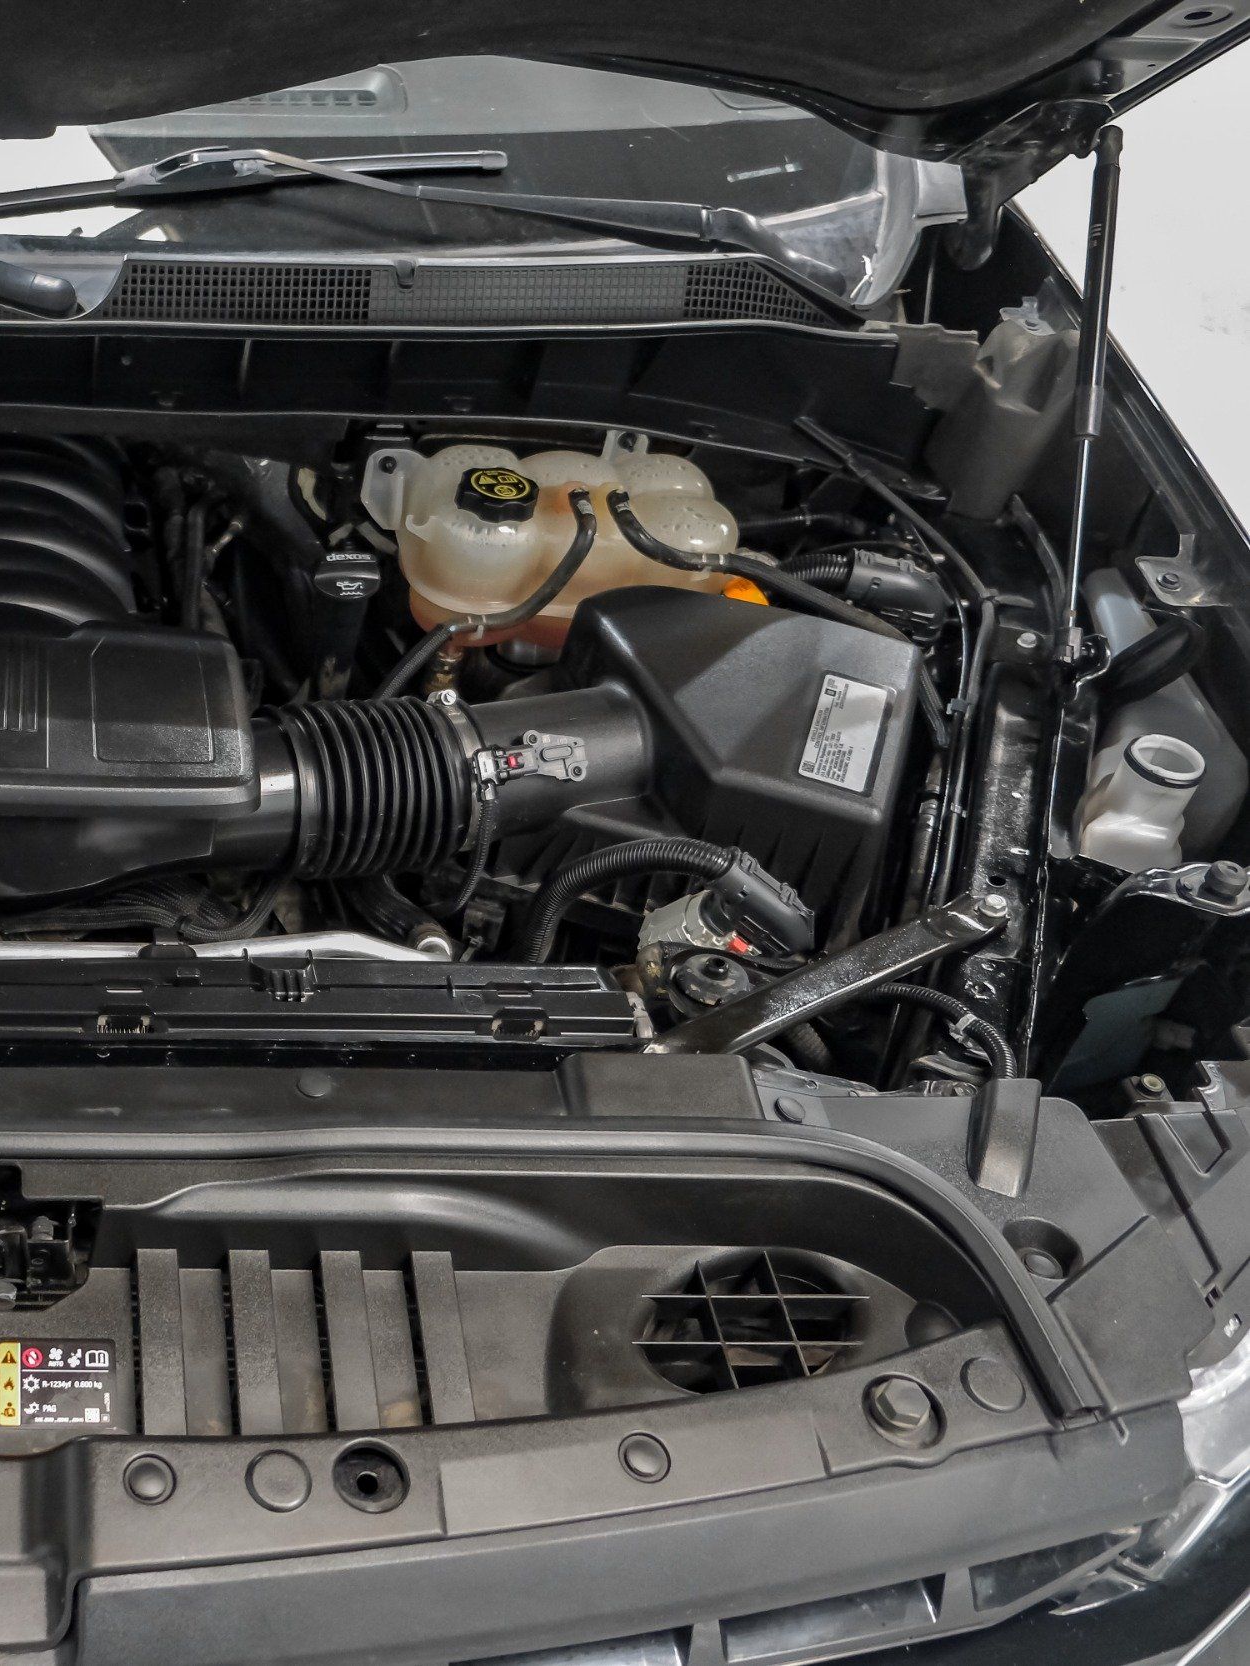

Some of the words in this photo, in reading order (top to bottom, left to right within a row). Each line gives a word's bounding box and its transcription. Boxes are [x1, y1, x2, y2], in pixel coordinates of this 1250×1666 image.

[326, 553, 371, 561] dexos
[42, 1381, 72, 1389] R-1234yf
[93, 1381, 102, 1389] kg
